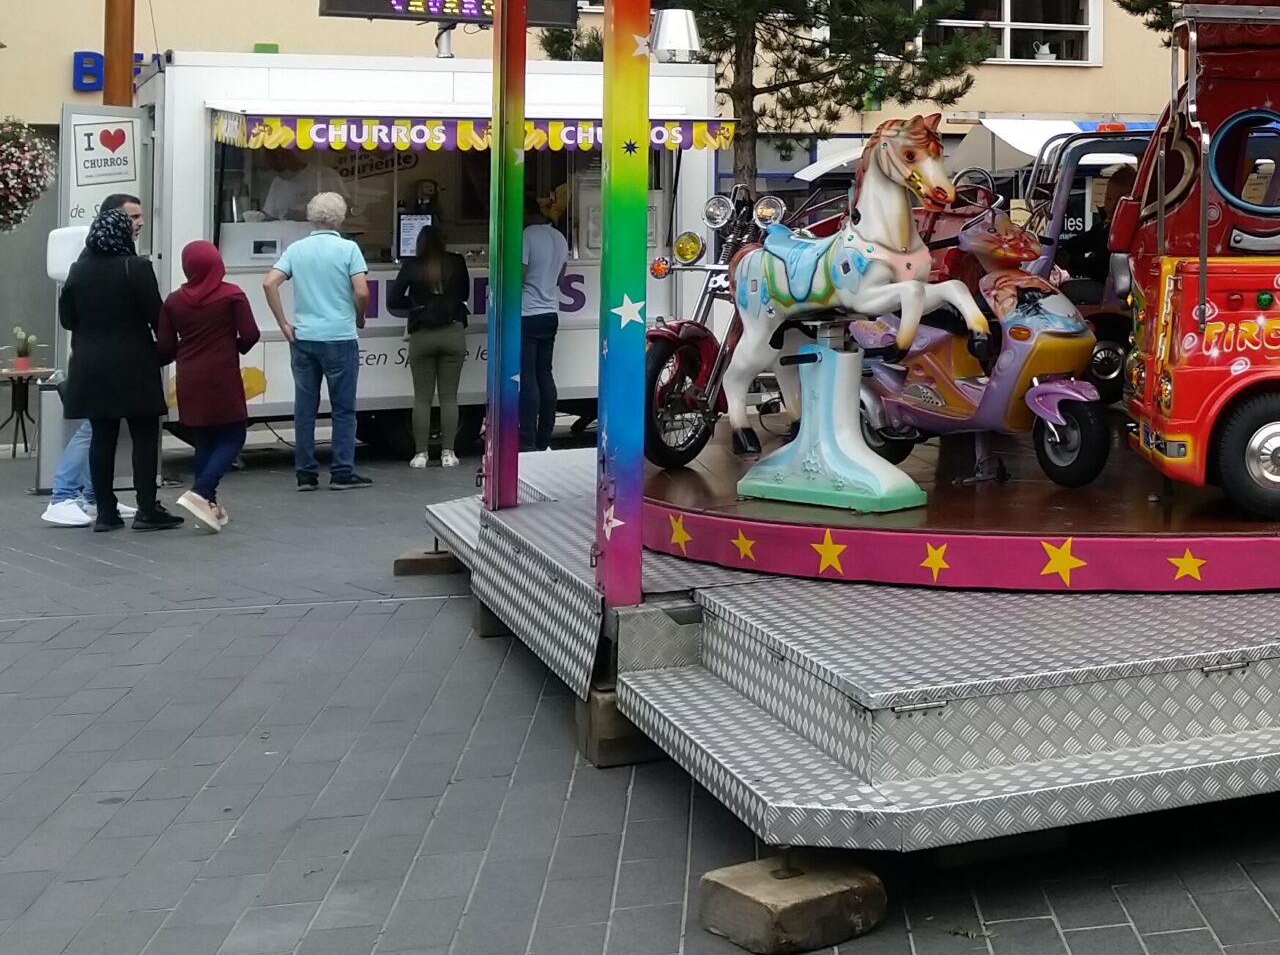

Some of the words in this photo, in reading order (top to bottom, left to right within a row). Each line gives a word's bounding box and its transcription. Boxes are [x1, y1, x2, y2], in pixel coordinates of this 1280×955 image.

[83, 132, 95, 151] I
[309, 123, 447, 144] CHURROS
[83, 156, 129, 170] CHURROS
[70, 205, 85, 219] de
